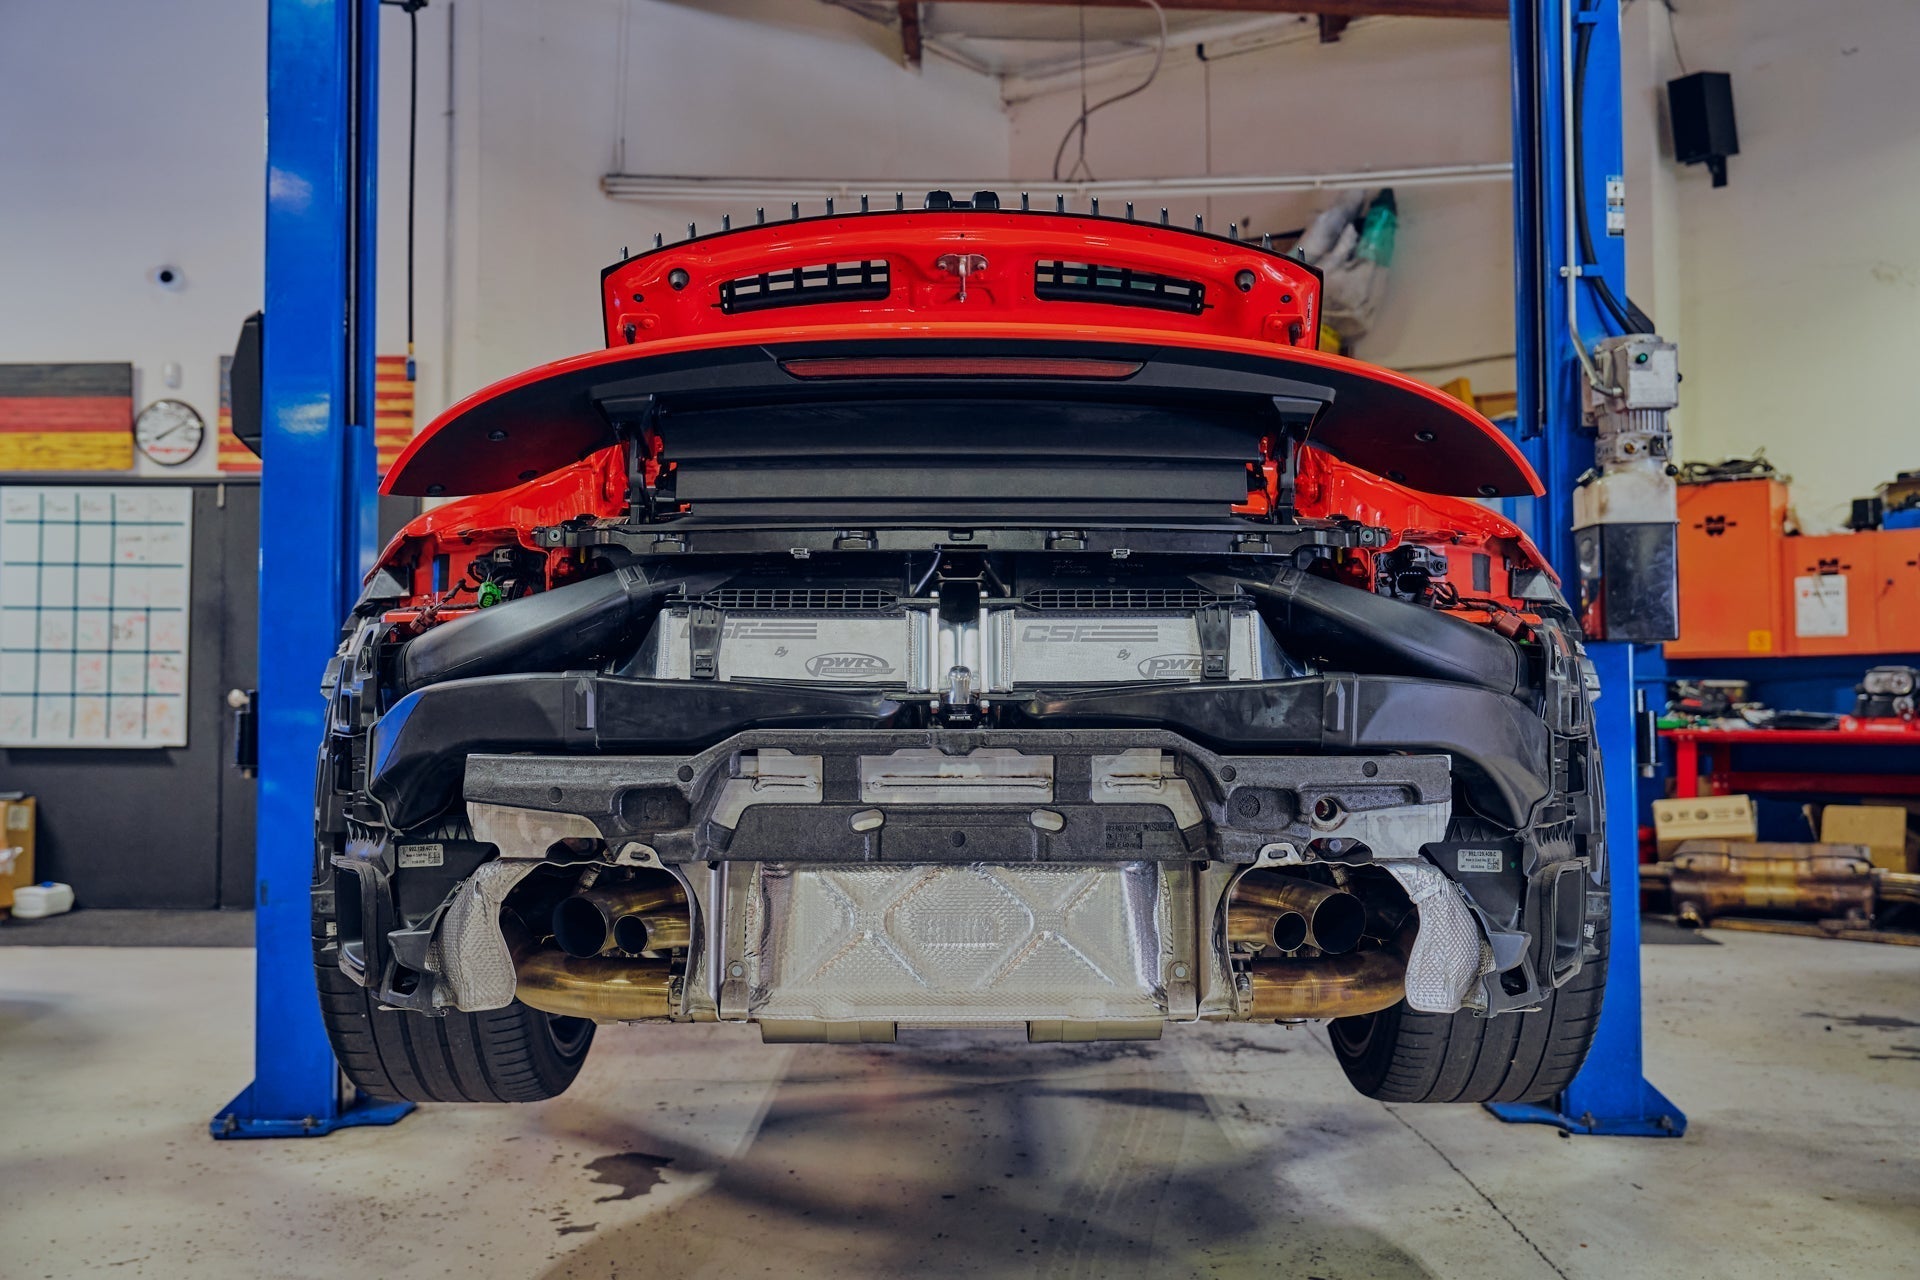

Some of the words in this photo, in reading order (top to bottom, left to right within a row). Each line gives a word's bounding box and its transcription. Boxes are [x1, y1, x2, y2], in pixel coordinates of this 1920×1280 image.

[1022, 625, 1103, 642] CSF
[774, 646, 789, 657] By
[1116, 649, 1131, 660] By
[811, 657, 876, 677] PWR
